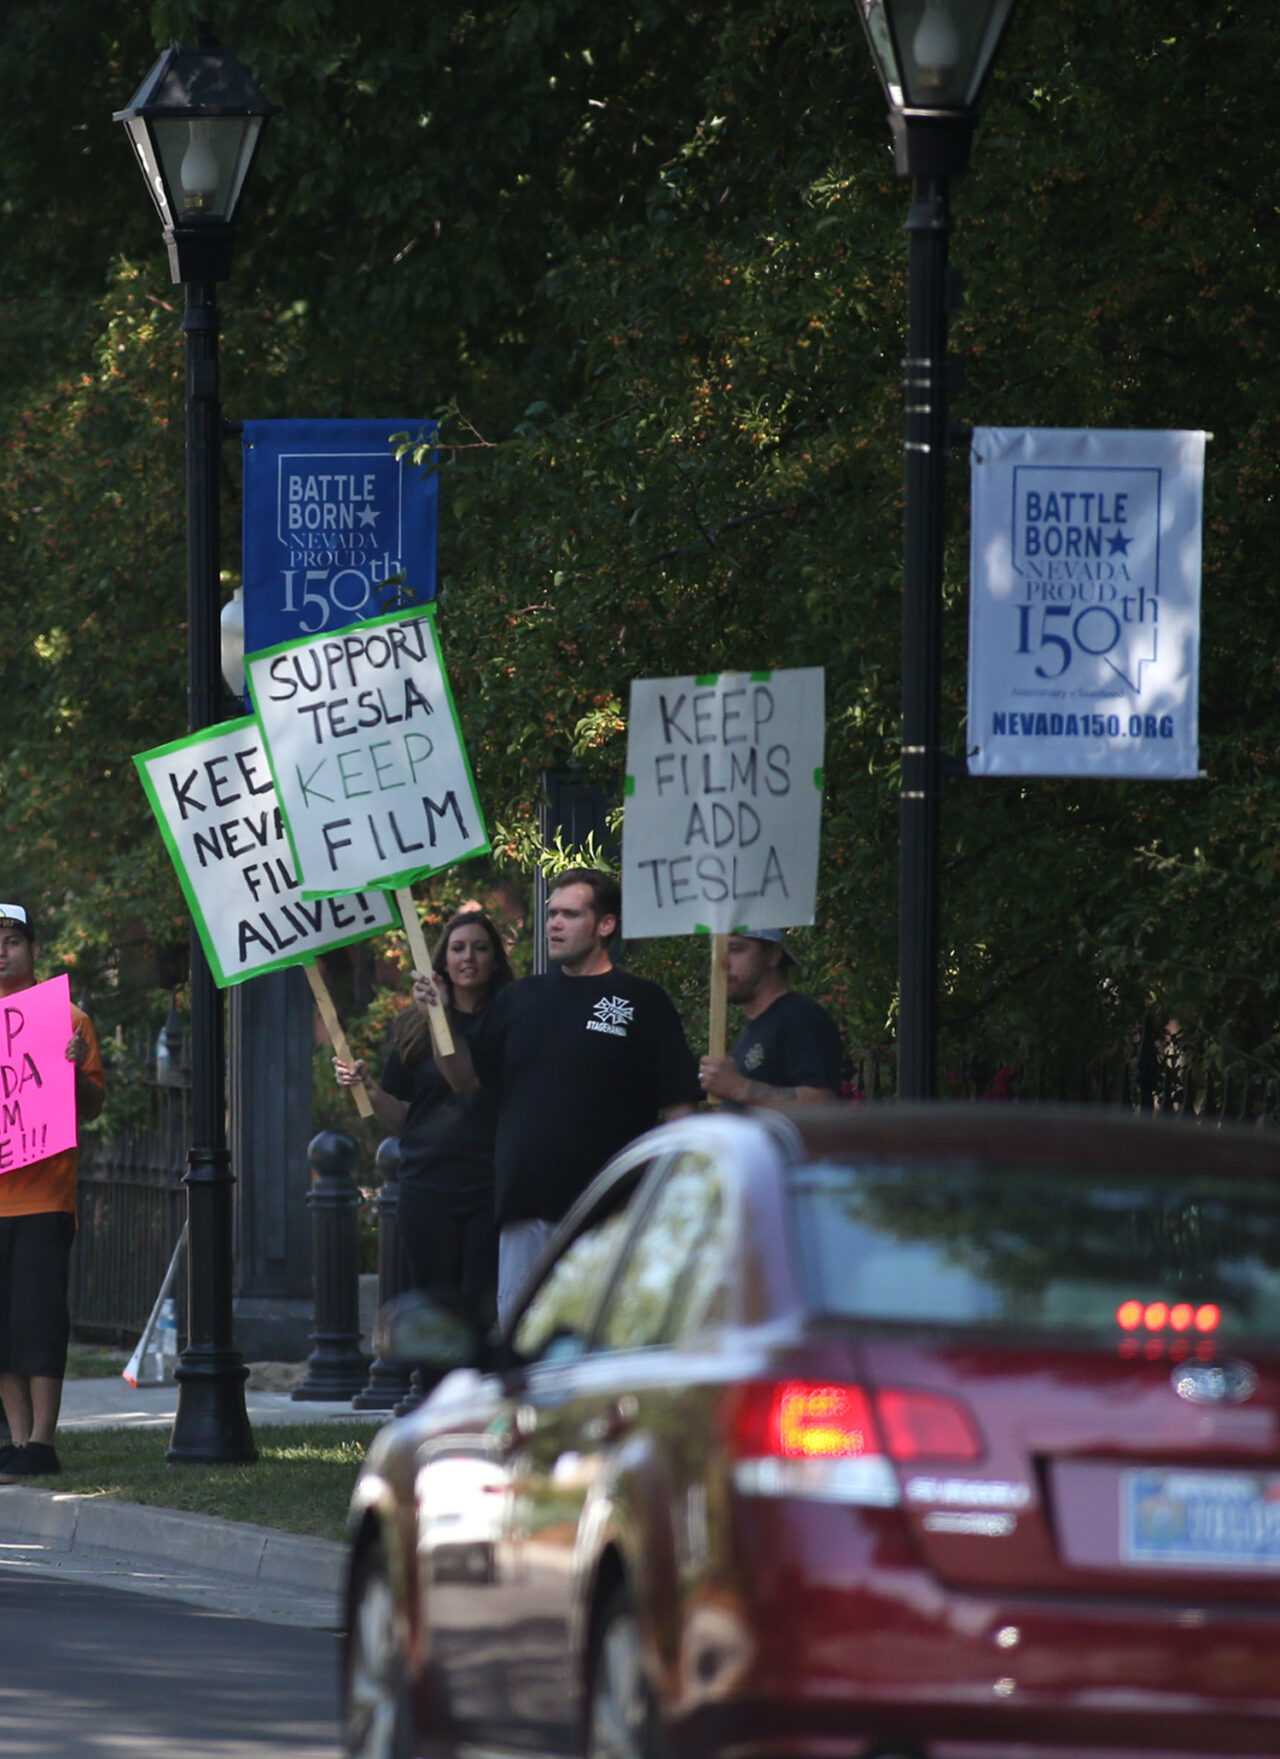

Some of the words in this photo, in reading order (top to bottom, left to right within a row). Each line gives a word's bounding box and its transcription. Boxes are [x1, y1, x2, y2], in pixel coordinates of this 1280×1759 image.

[288, 475, 376, 501] BATTLE
[1026, 491, 1128, 523] BATTLE
[288, 503, 355, 529] BORN
[289, 532, 379, 549] NEVADA
[289, 551, 366, 567] PROUD
[1025, 526, 1103, 557] BORN
[1021, 560, 1131, 581] NEVADA
[1025, 581, 1118, 601] PROUD
[269, 617, 428, 701] SUPPORT
[297, 677, 434, 744] TESLA
[659, 686, 775, 746] KEEP
[992, 712, 1174, 738] NEVADA150.ORG
[169, 746, 275, 820] KEE
[295, 732, 434, 809] KEEP
[655, 744, 791, 797] FILMS
[322, 790, 470, 872] FILM
[684, 801, 762, 848] ADD
[242, 858, 301, 902] FIL
[638, 845, 789, 908] TESLA
